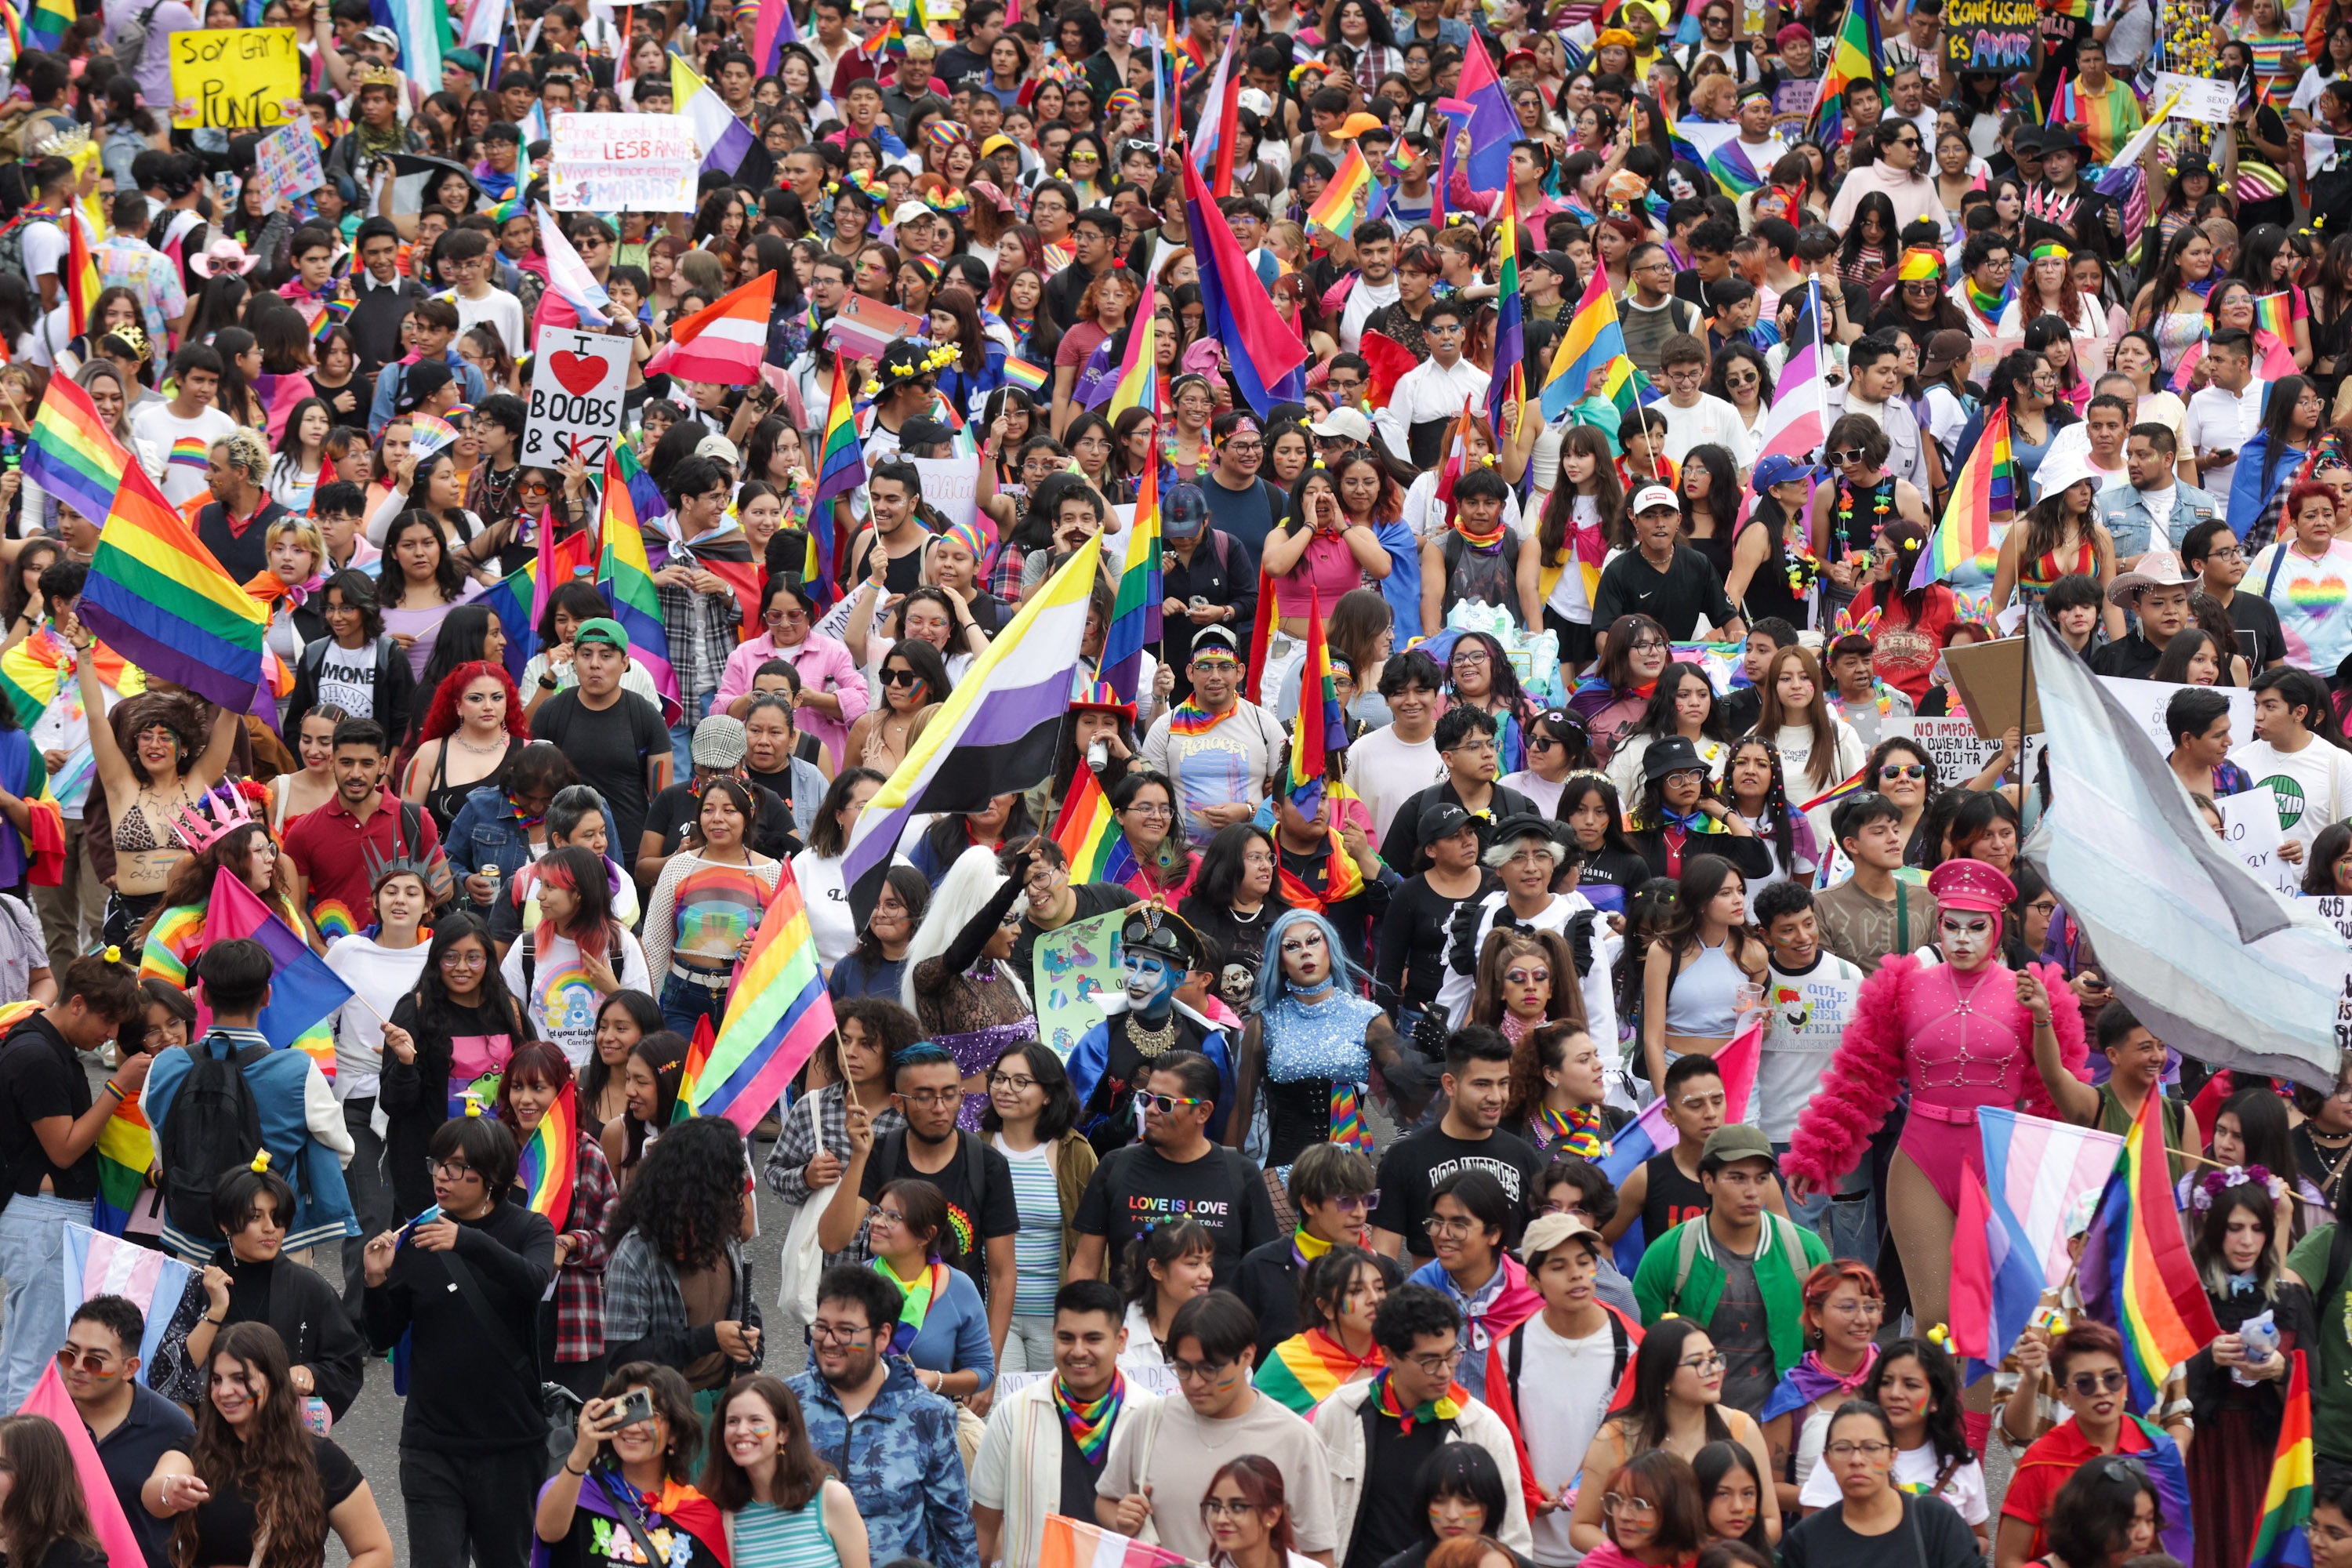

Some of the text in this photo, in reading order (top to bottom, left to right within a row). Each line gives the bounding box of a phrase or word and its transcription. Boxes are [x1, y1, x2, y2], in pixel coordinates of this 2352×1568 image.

[181, 31, 296, 64] SOY GAY Y
[1950, 29, 2031, 67] ES AMOR
[203, 79, 281, 132] PUNTO
[2207, 96, 2230, 104] SEXO
[573, 335, 593, 356] I
[530, 389, 616, 427] BOOBS
[525, 428, 612, 468] & SKZ
[920, 474, 976, 500] MAM
[1193, 647, 1211, 661] PRIDE
[1217, 647, 1235, 661] 2024
[1914, 722, 1933, 736] NO
[1928, 737, 1963, 750] QUIEN
[1965, 738, 1981, 750] LE
[129, 854, 168, 882] Syst
[2318, 897, 2344, 918] NO
[1806, 983, 1848, 1002] QUIE
[1814, 998, 1838, 1010] RO
[1809, 1009, 1842, 1021] SER
[557, 1030, 578, 1039] your
[1769, 1039, 1841, 1050] VALIENT
[1129, 1196, 1229, 1216] LOVE IS LOVE
[1198, 1218, 1224, 1229] ての人に
[1003, 1374, 1024, 1395] NO
